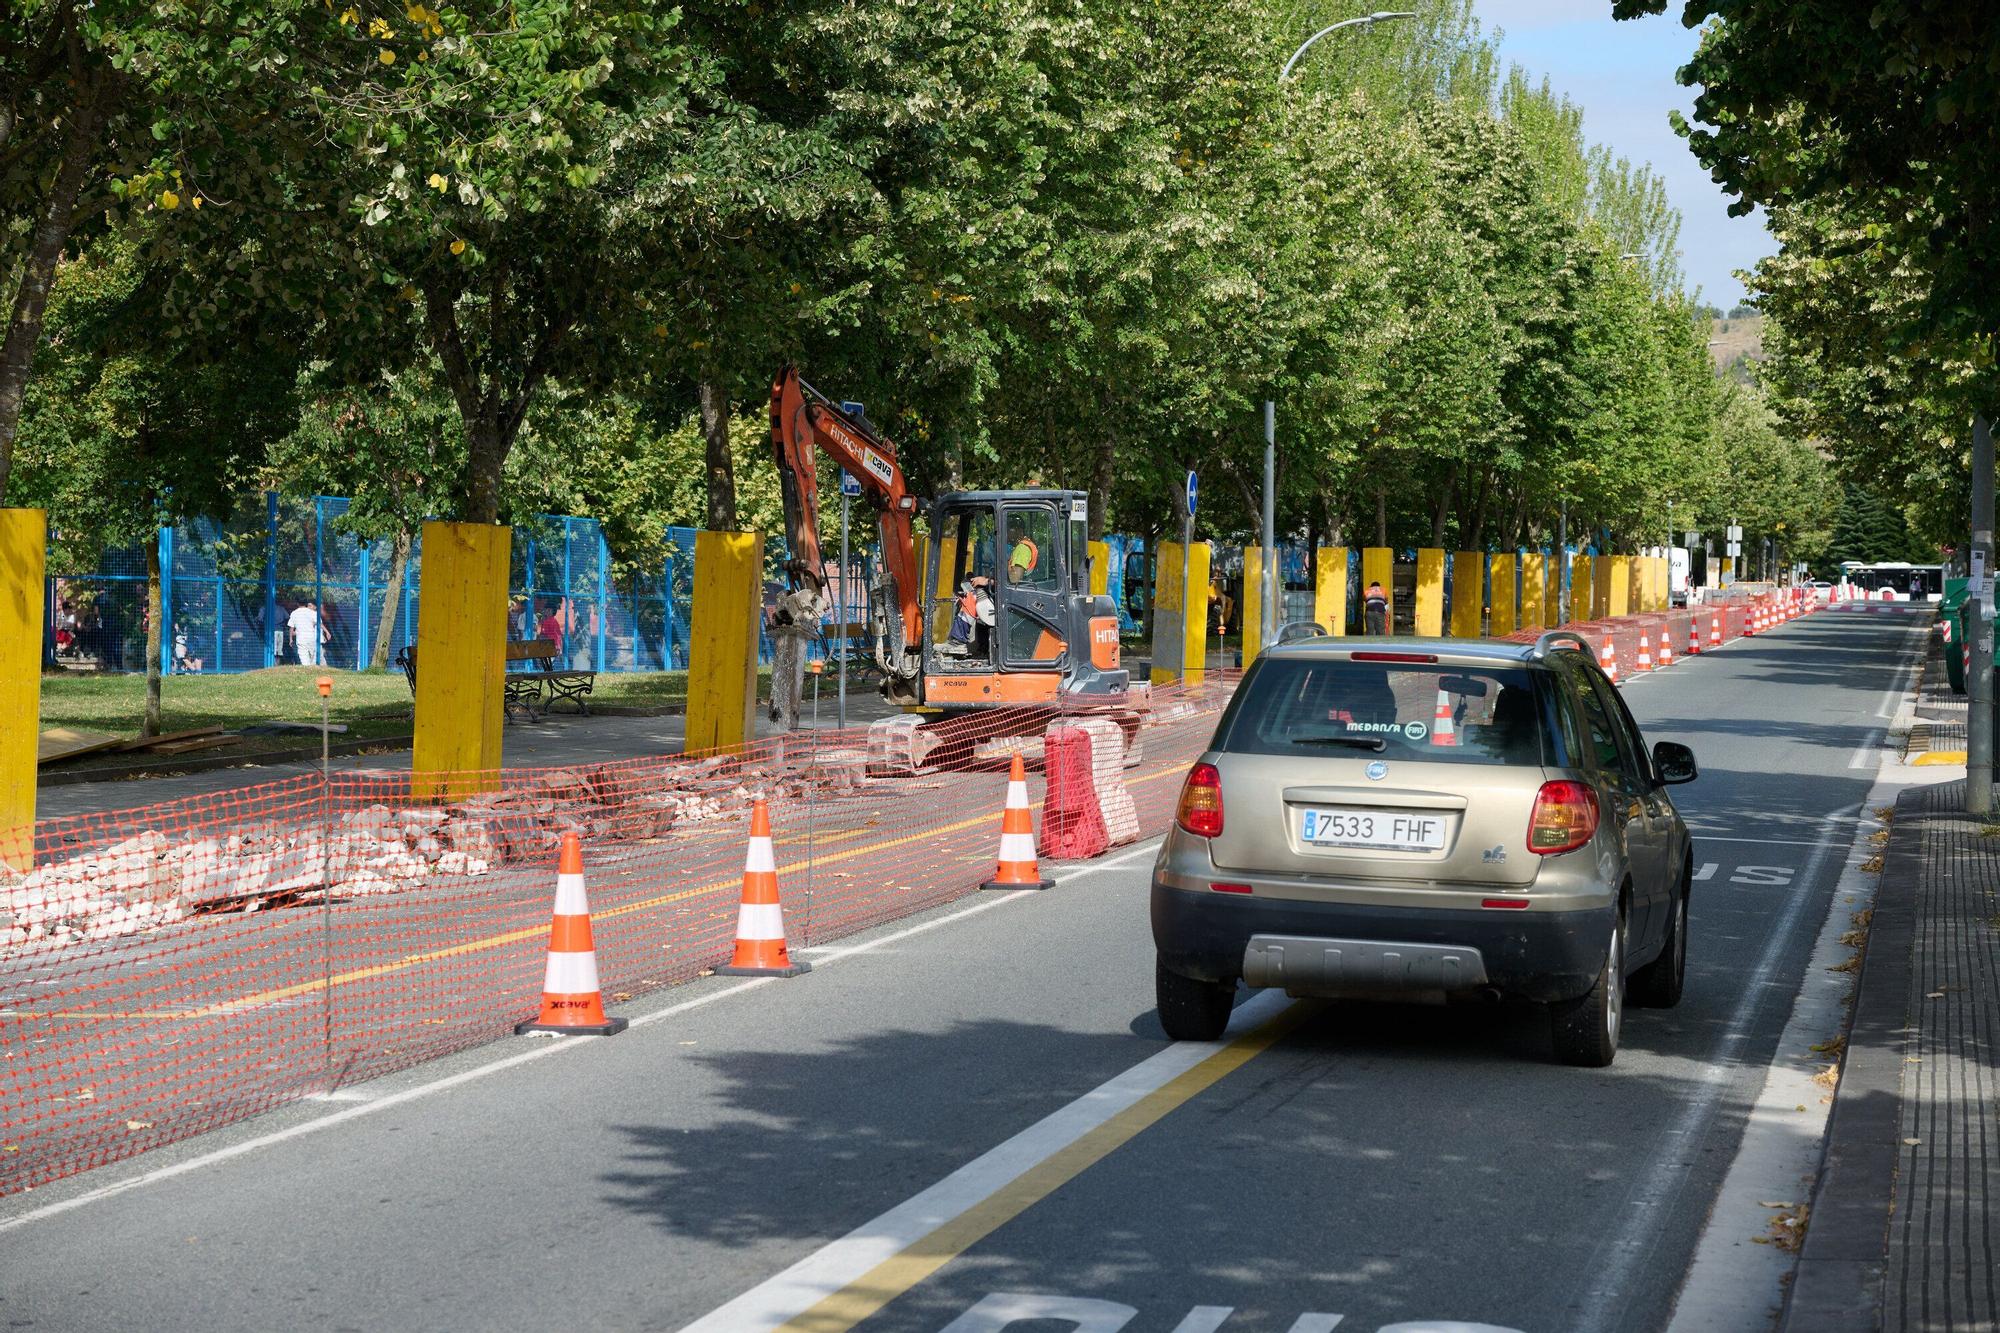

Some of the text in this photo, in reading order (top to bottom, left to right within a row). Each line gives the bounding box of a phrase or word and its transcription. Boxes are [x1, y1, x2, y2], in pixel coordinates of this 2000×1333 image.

[830, 424, 864, 460] HITACHI
[1318, 815, 1374, 839] 7533
[1393, 818, 1436, 843] FHF
